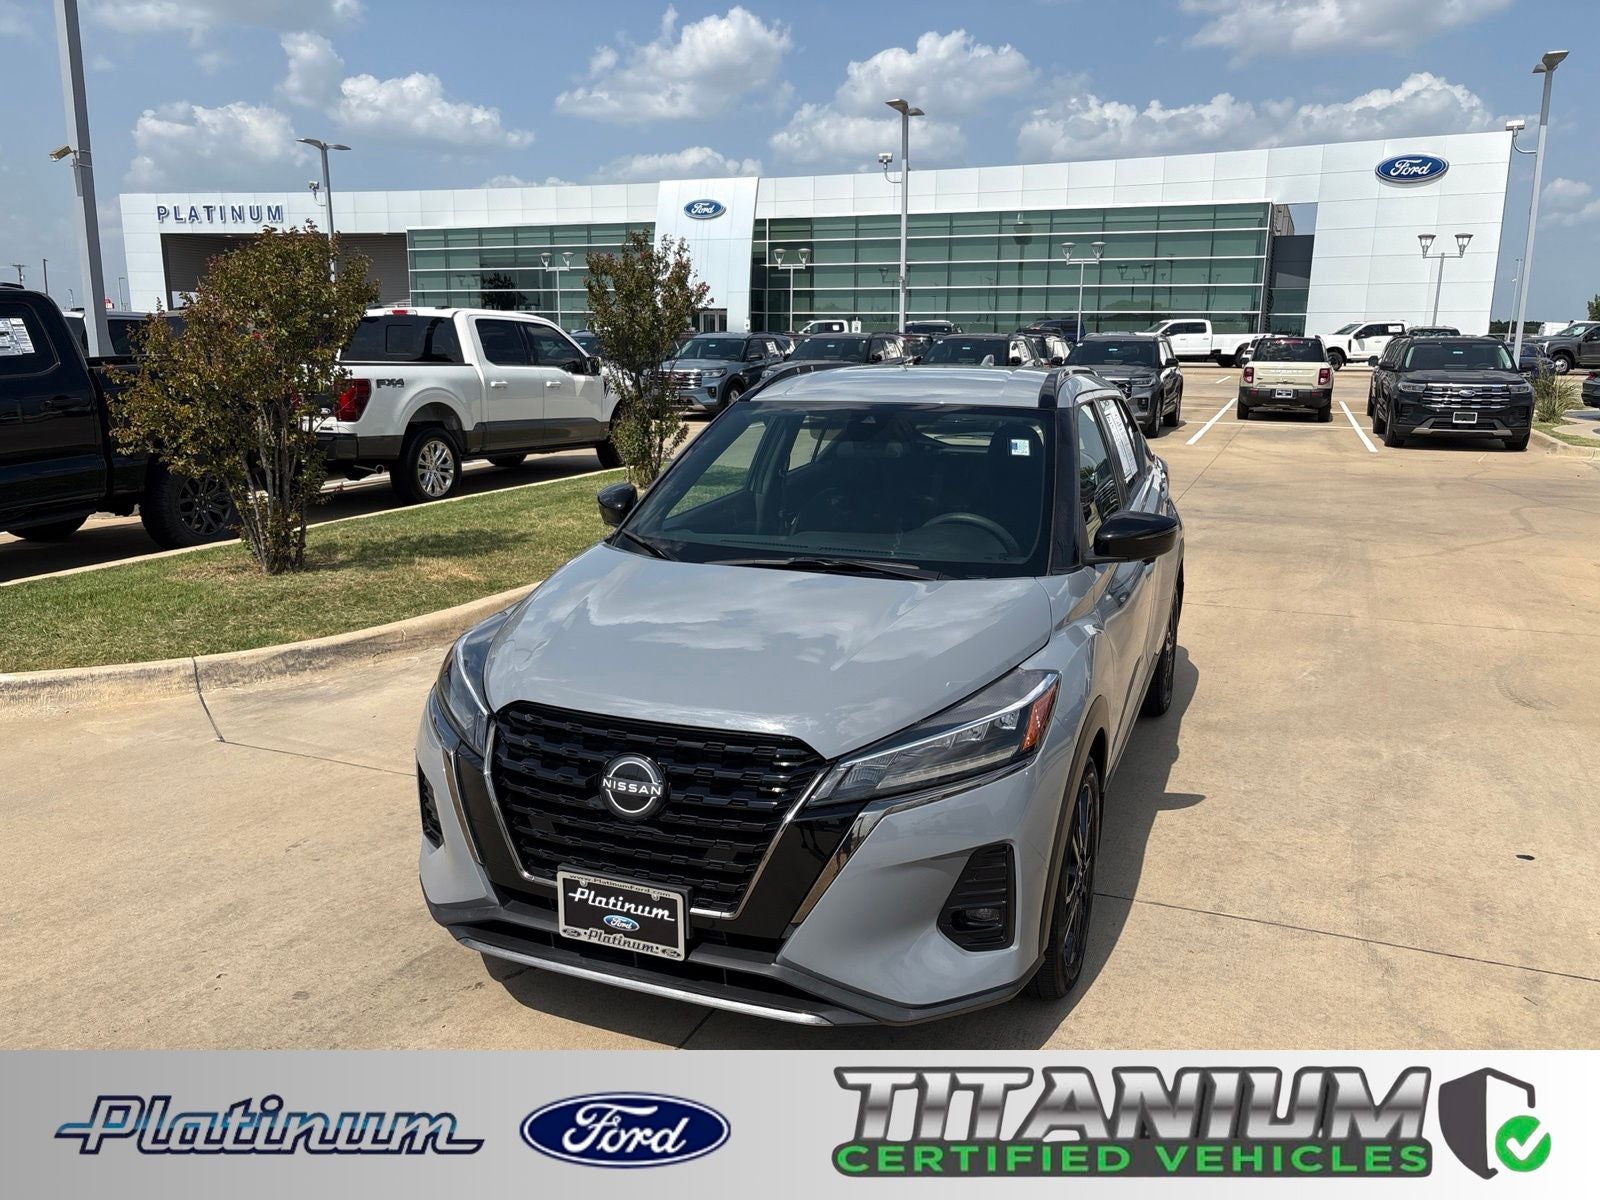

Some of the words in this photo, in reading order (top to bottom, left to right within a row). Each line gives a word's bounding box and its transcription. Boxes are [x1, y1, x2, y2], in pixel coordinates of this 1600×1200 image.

[156, 204, 284, 224] PLATINUM
[376, 378, 405, 388] FX4
[602, 778, 662, 796] NISSAN
[568, 887, 676, 922] Platinum
